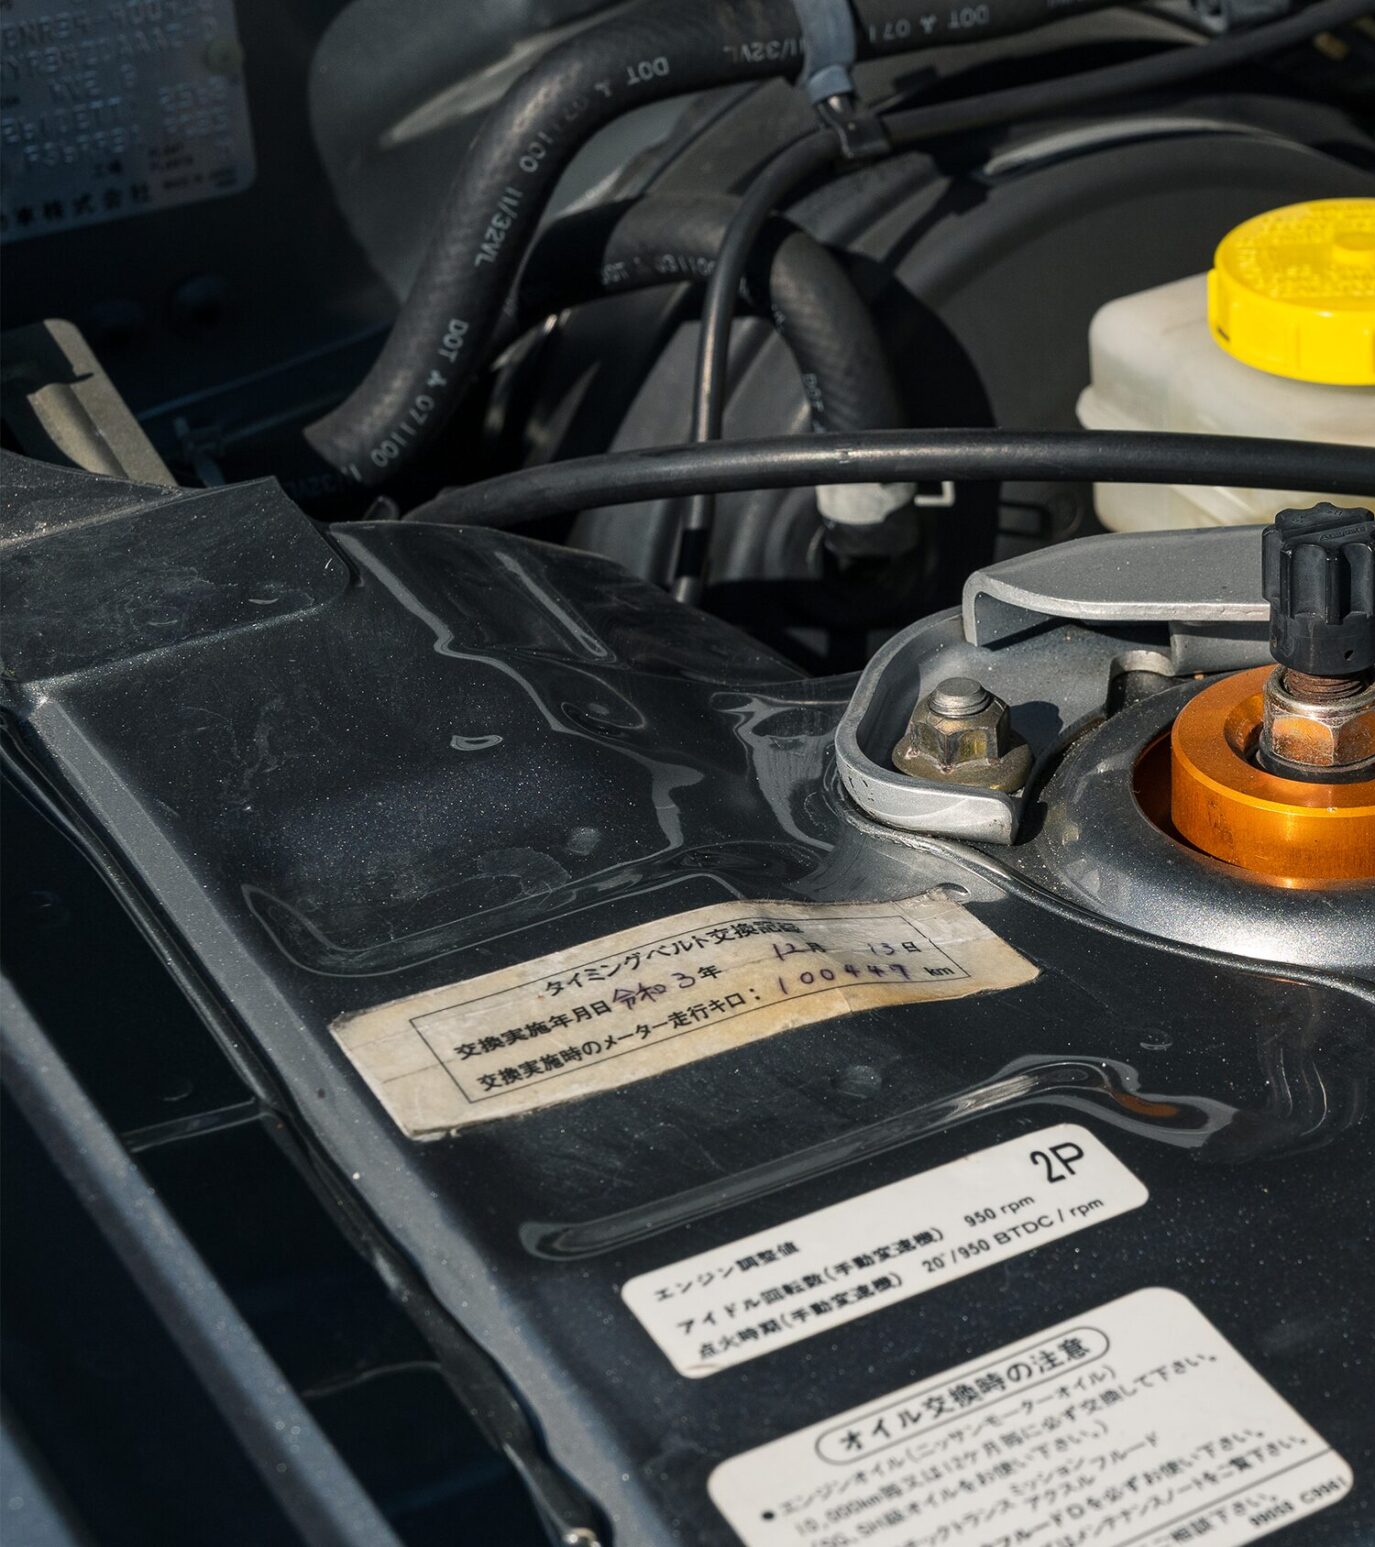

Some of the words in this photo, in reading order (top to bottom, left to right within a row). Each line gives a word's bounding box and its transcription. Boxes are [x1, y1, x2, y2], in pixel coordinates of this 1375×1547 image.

[949, 4, 991, 30] DOT
[625, 56, 671, 86] DOT
[474, 185, 524, 268] 11/32VL
[437, 318, 470, 363] DOT
[370, 394, 435, 468] 071100
[923, 965, 955, 977] km
[1029, 1141, 1085, 1184] 2P
[963, 1207, 997, 1228] 950
[1000, 1196, 1036, 1217] rpm
[993, 1214, 1054, 1245] BTDC
[1069, 1198, 1105, 1219] rpm
[654, 1240, 801, 1302] エンジン調整値
[840, 1336, 1091, 1452] オイル交換時の注意
